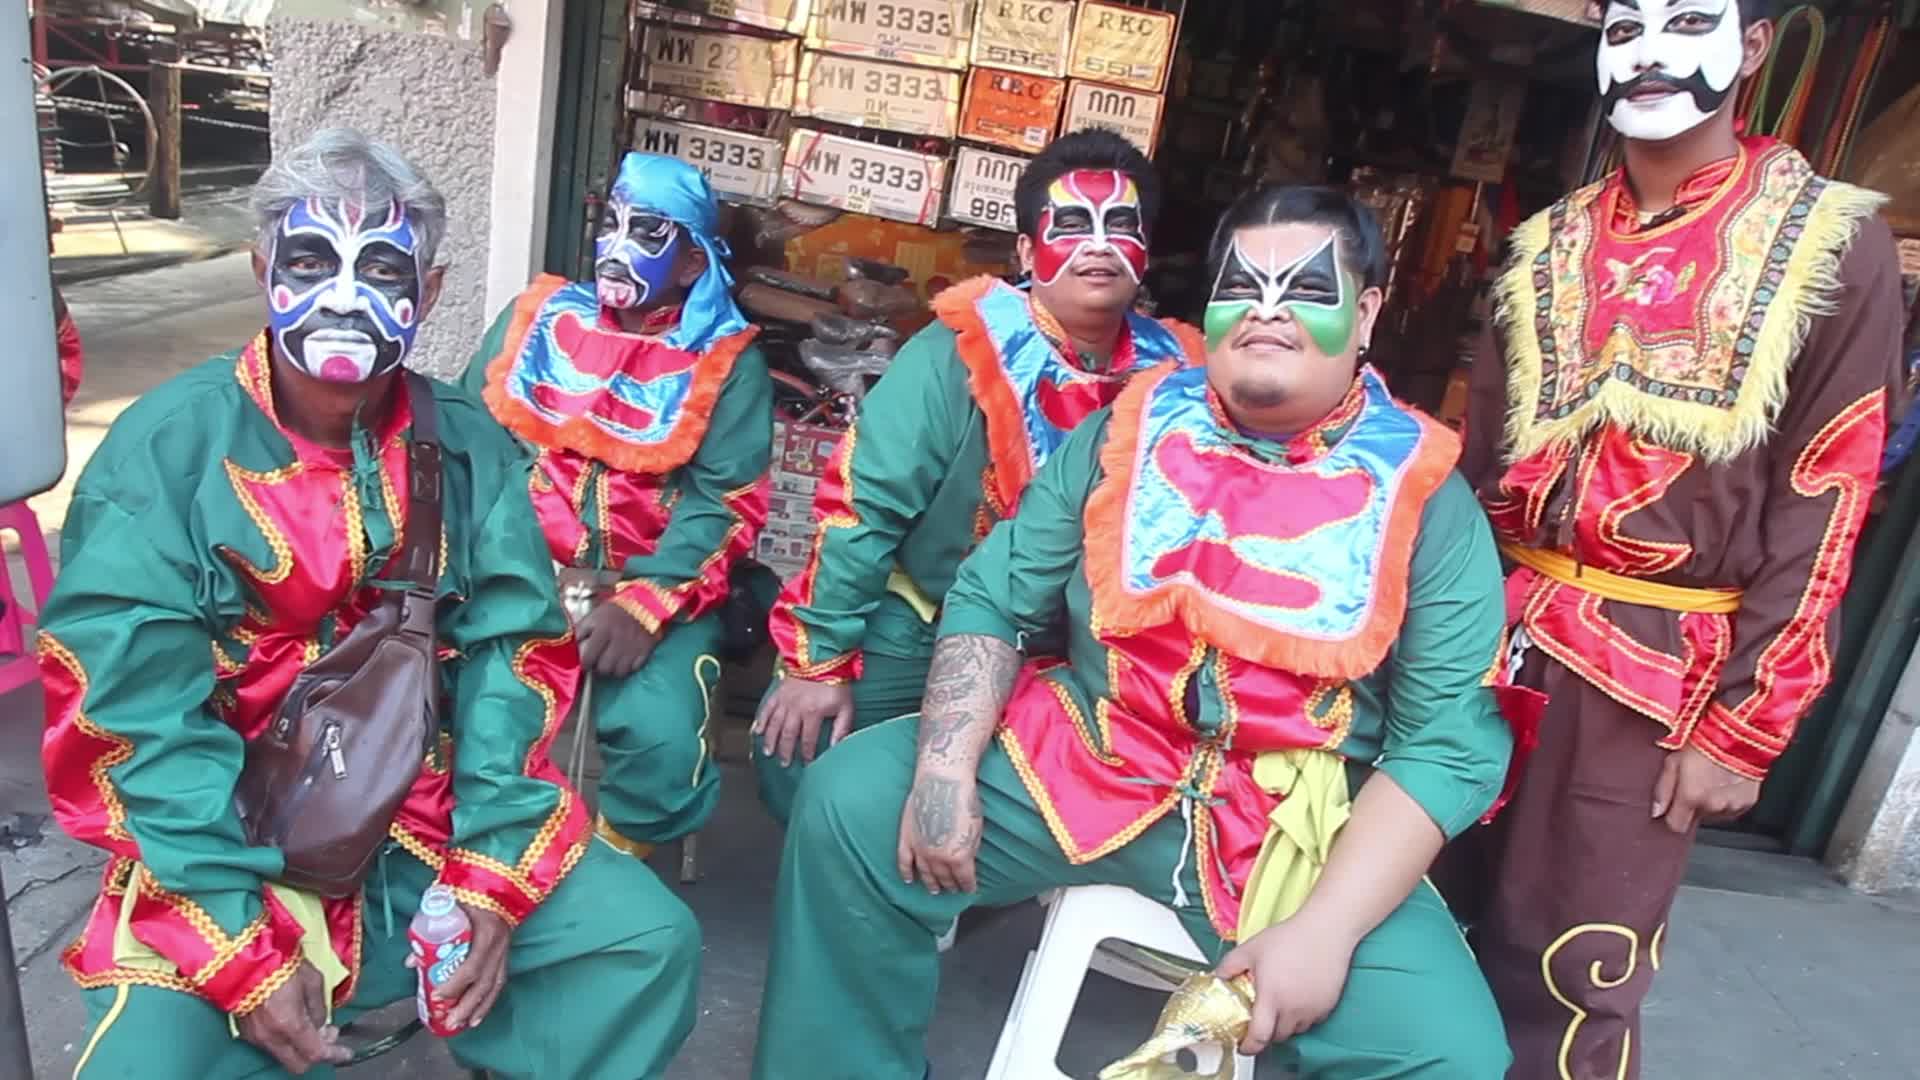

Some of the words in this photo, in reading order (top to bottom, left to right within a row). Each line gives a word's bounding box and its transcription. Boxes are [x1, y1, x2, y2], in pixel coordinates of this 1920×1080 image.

[876, 4, 953, 36] 3333
[998, 1, 1054, 24] RKC
[1098, 12, 1153, 36] RKC
[864, 70, 942, 101] 3333
[689, 137, 765, 169] 3333
[848, 158, 924, 192] 3333
